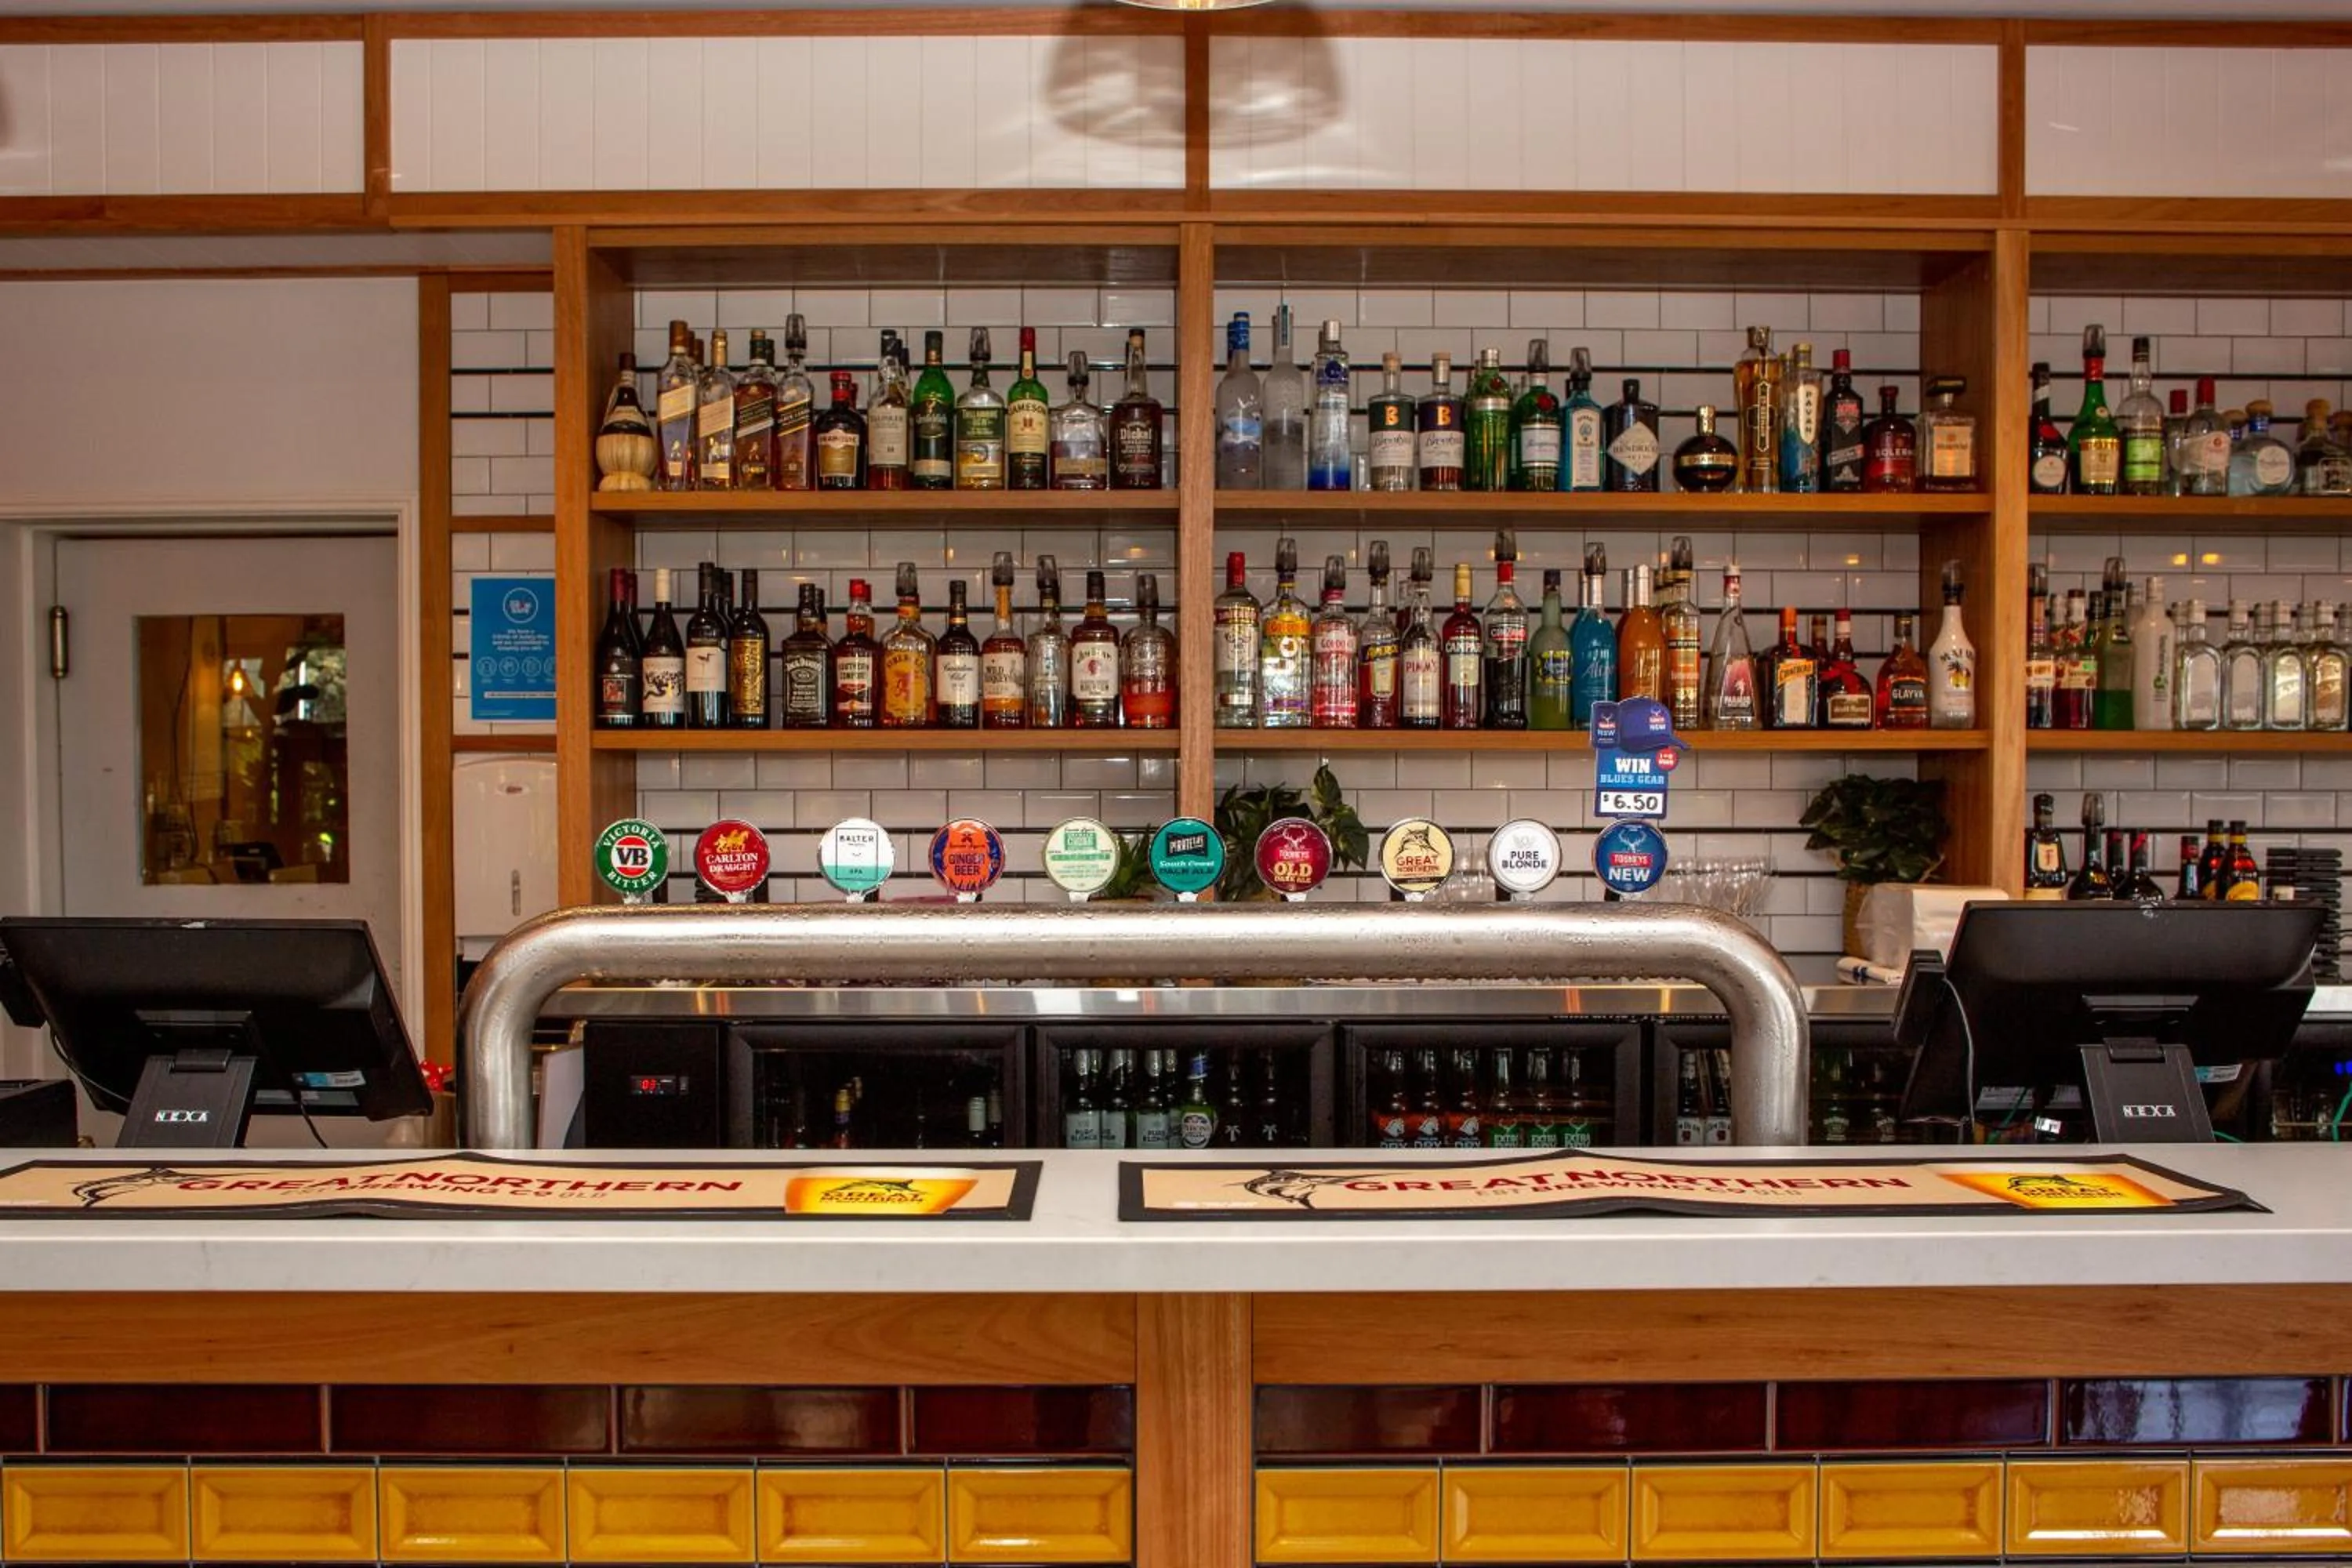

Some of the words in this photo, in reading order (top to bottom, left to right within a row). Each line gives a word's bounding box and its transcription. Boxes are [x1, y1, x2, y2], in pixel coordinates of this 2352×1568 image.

[1008, 399, 1047, 414] JAMESON
[1385, 405, 1399, 426] B
[1437, 405, 1451, 426] B
[1445, 641, 1483, 653] CAMPAR
[1892, 689, 1924, 699] GLAYVA
[1615, 758, 1651, 774] WIN
[1600, 774, 1634, 784] BLUES
[1638, 775, 1665, 785] GEAR
[603, 823, 660, 849] VICTORIA
[617, 847, 648, 866] VB
[706, 852, 758, 864] CARLTON
[949, 853, 985, 865] GINGER
[1396, 855, 1438, 866] GREAT
[1510, 851, 1539, 860] PURE
[709, 862, 757, 873] DRAUGHT
[954, 865, 980, 876] BEER
[1274, 862, 1313, 877] OLD
[1501, 860, 1548, 869] BLONDE
[608, 871, 658, 888] BITTER
[1608, 867, 1650, 882] NEW
[155, 1109, 209, 1122] NEXA
[2122, 1105, 2176, 1117] NEXA
[178, 1174, 389, 1191] GREAT
[392, 1171, 743, 1192] NORTHERN
[1343, 1173, 1555, 1191] GREAT
[1564, 1170, 1913, 1188] NORTHERN
[1530, 1181, 1694, 1192] BREWING
[338, 1182, 499, 1193] BREWING
